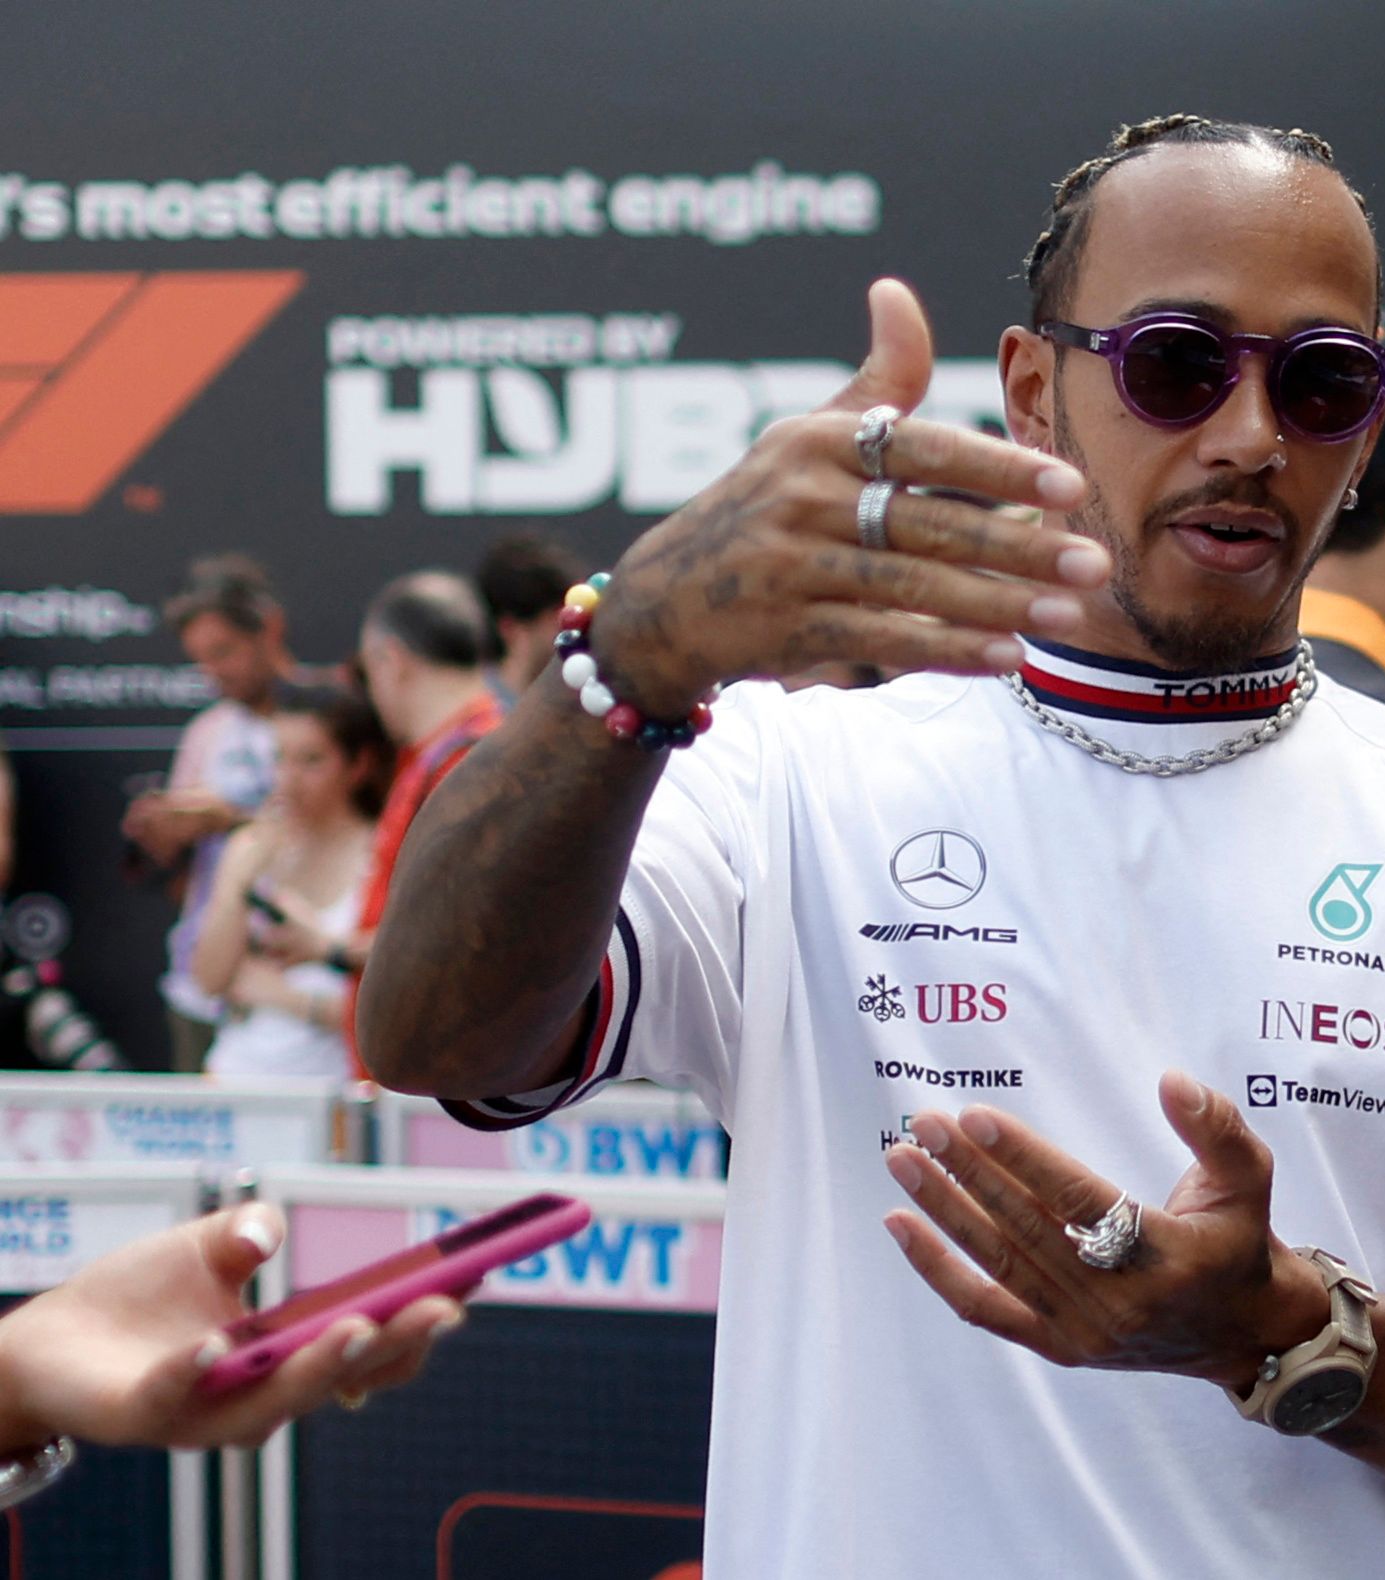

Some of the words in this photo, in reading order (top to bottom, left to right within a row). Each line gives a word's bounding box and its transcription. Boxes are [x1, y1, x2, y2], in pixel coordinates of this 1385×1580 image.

[76, 171, 274, 241] most
[276, 161, 605, 241] efficient
[607, 158, 881, 246] engine
[327, 313, 598, 366] POWERED
[601, 312, 685, 363] BY
[1153, 673, 1289, 708] TOMMY
[903, 923, 1018, 943] AMG
[914, 983, 1008, 1024] UBS
[874, 1061, 1023, 1088] ROWDSTRIKE
